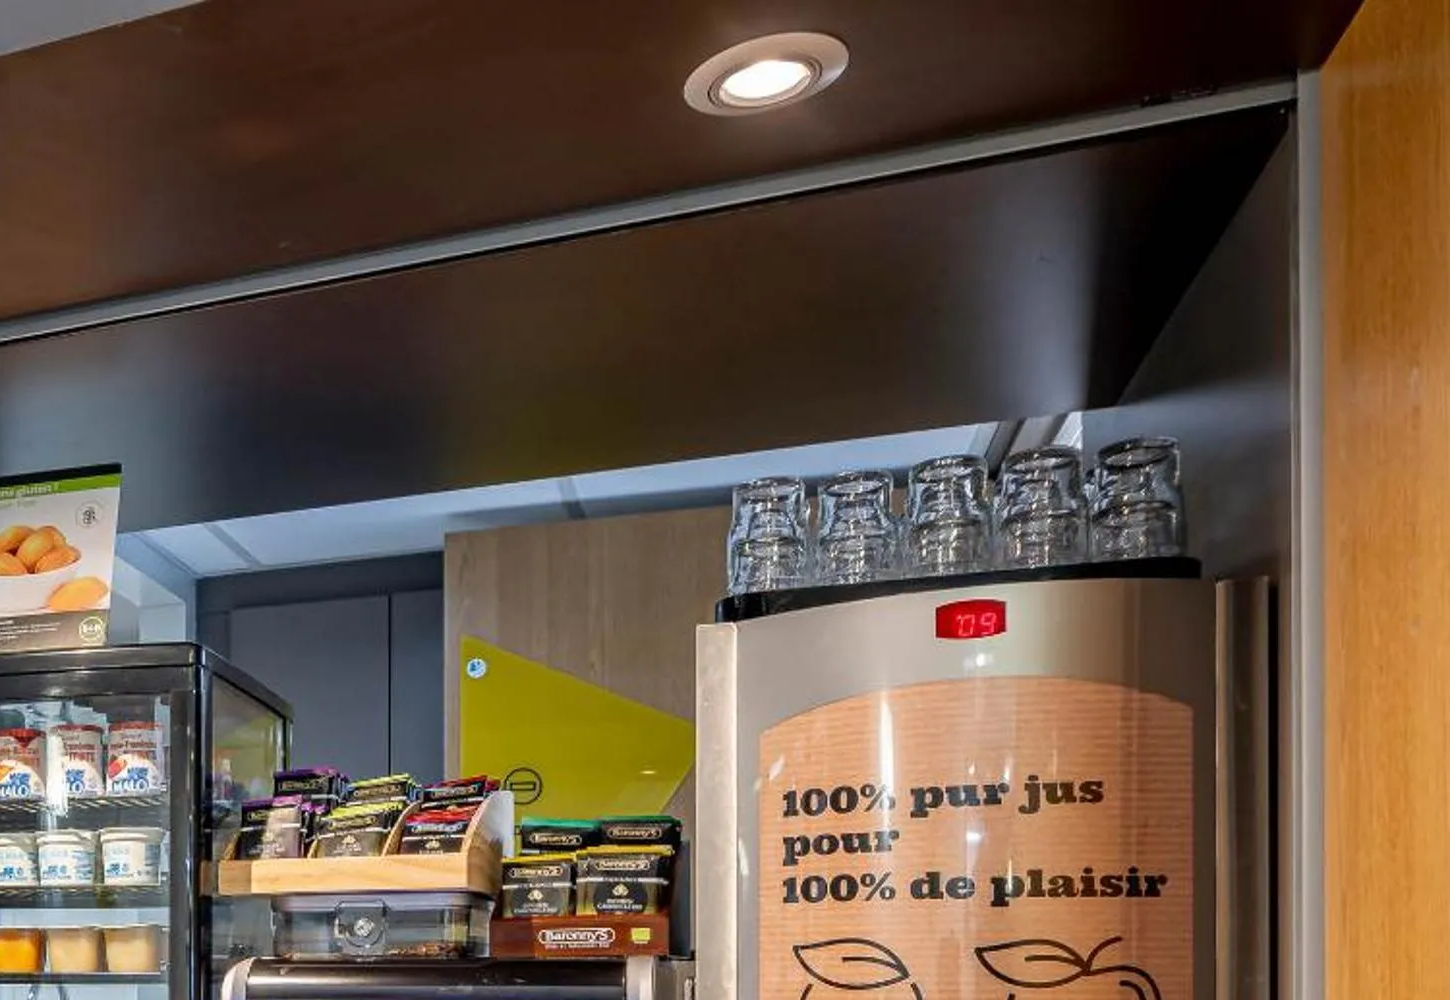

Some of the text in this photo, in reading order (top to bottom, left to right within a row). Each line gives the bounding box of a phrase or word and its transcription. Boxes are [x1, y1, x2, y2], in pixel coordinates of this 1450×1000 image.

[782, 775, 1105, 818] 100% pur jus
[782, 828, 900, 866] pour
[782, 866, 1169, 907] 100% de plaisir
